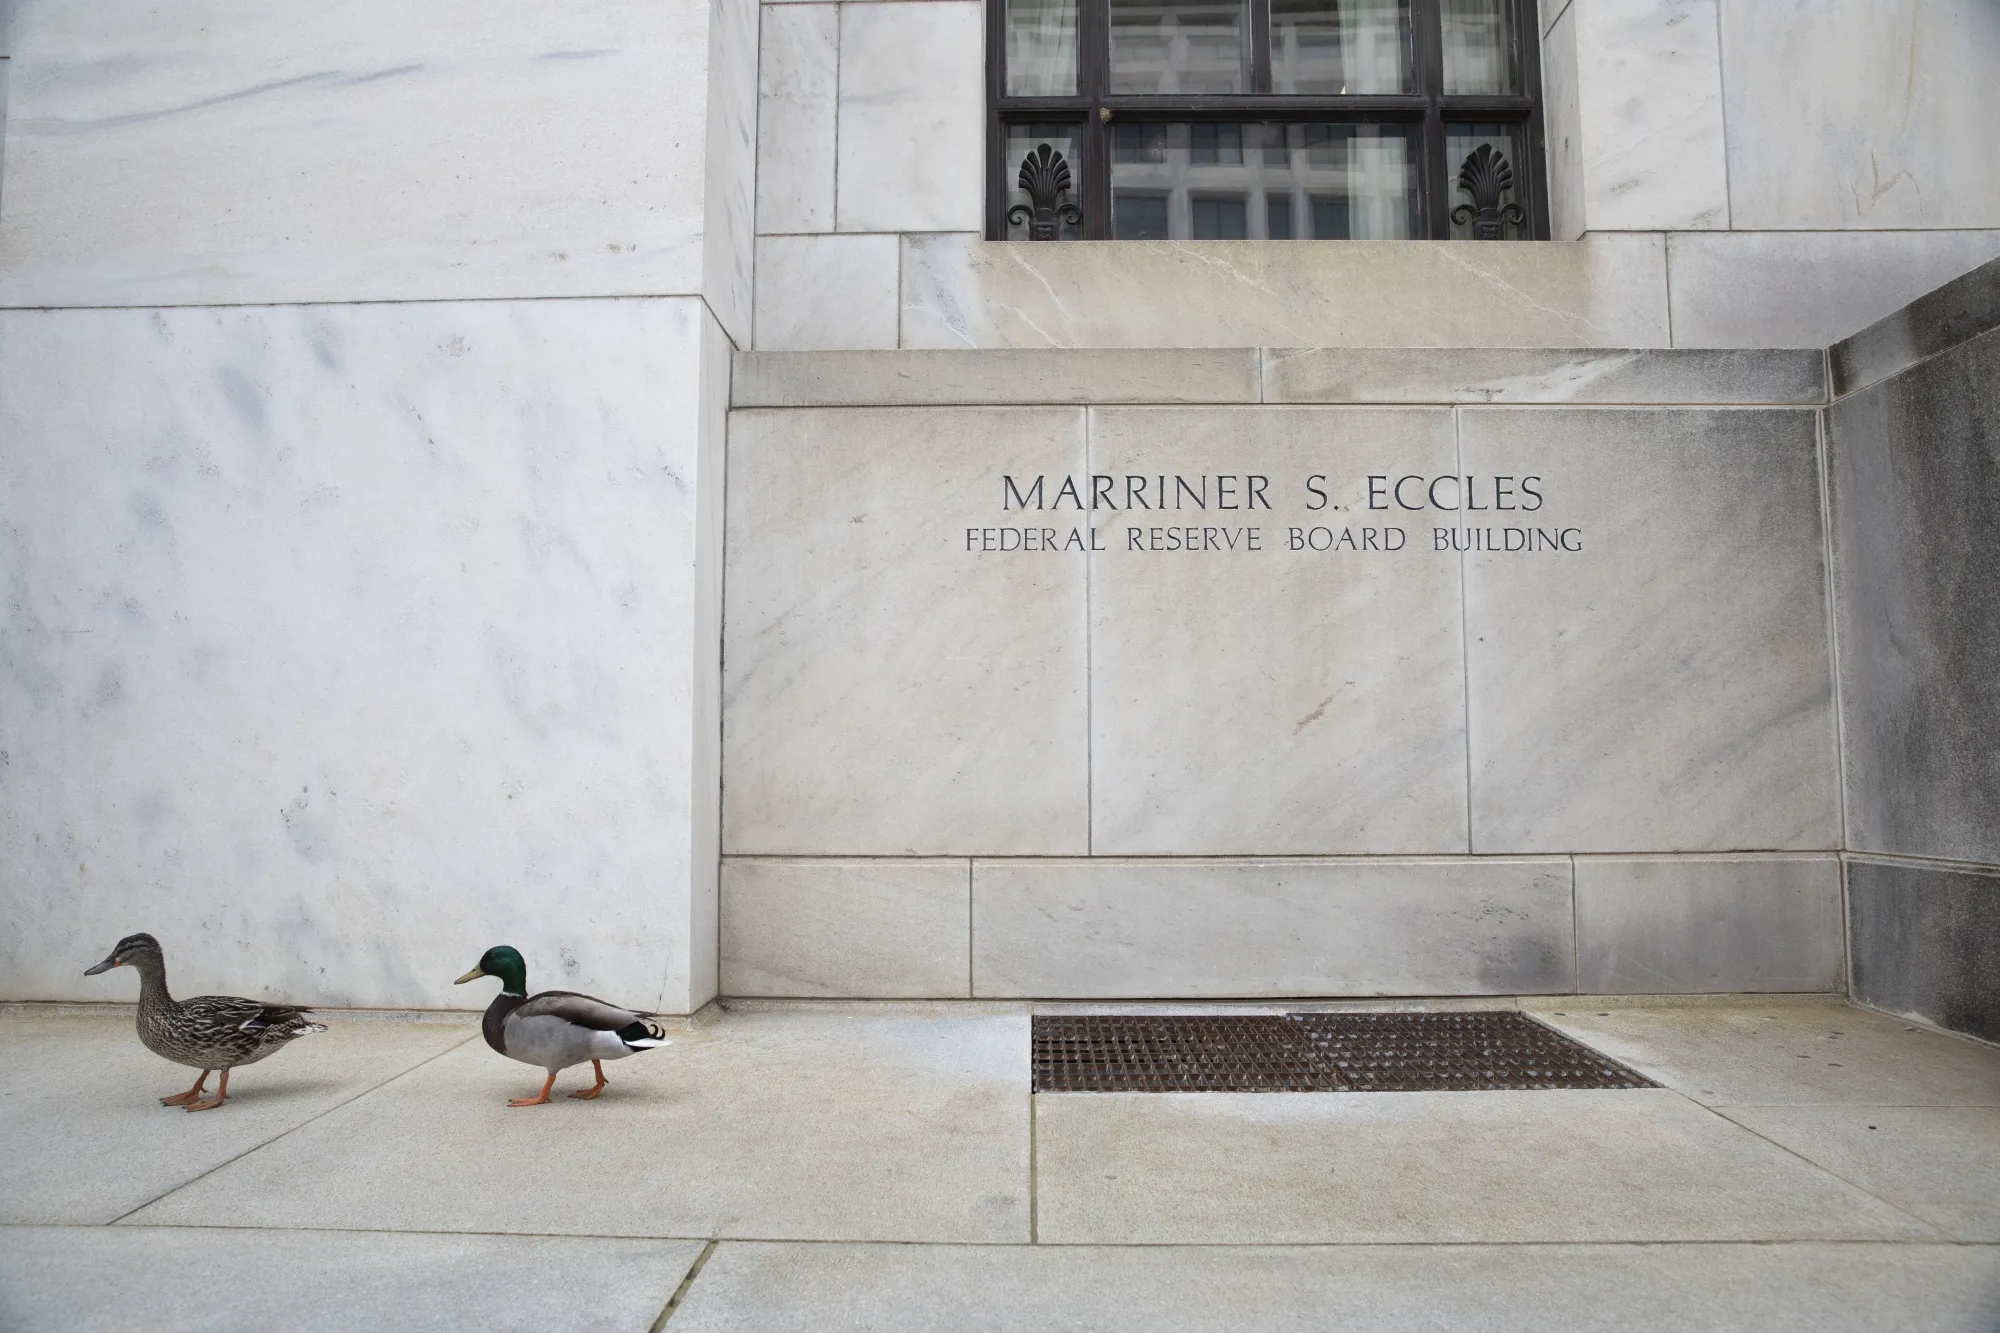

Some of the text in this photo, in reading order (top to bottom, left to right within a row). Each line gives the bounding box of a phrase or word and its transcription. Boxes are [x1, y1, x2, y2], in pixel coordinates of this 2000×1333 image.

[1003, 475, 1543, 511] MARRINER S. ECCLES
[966, 527, 1582, 552] FEDERAL RESERVE BOARD BUILDING
